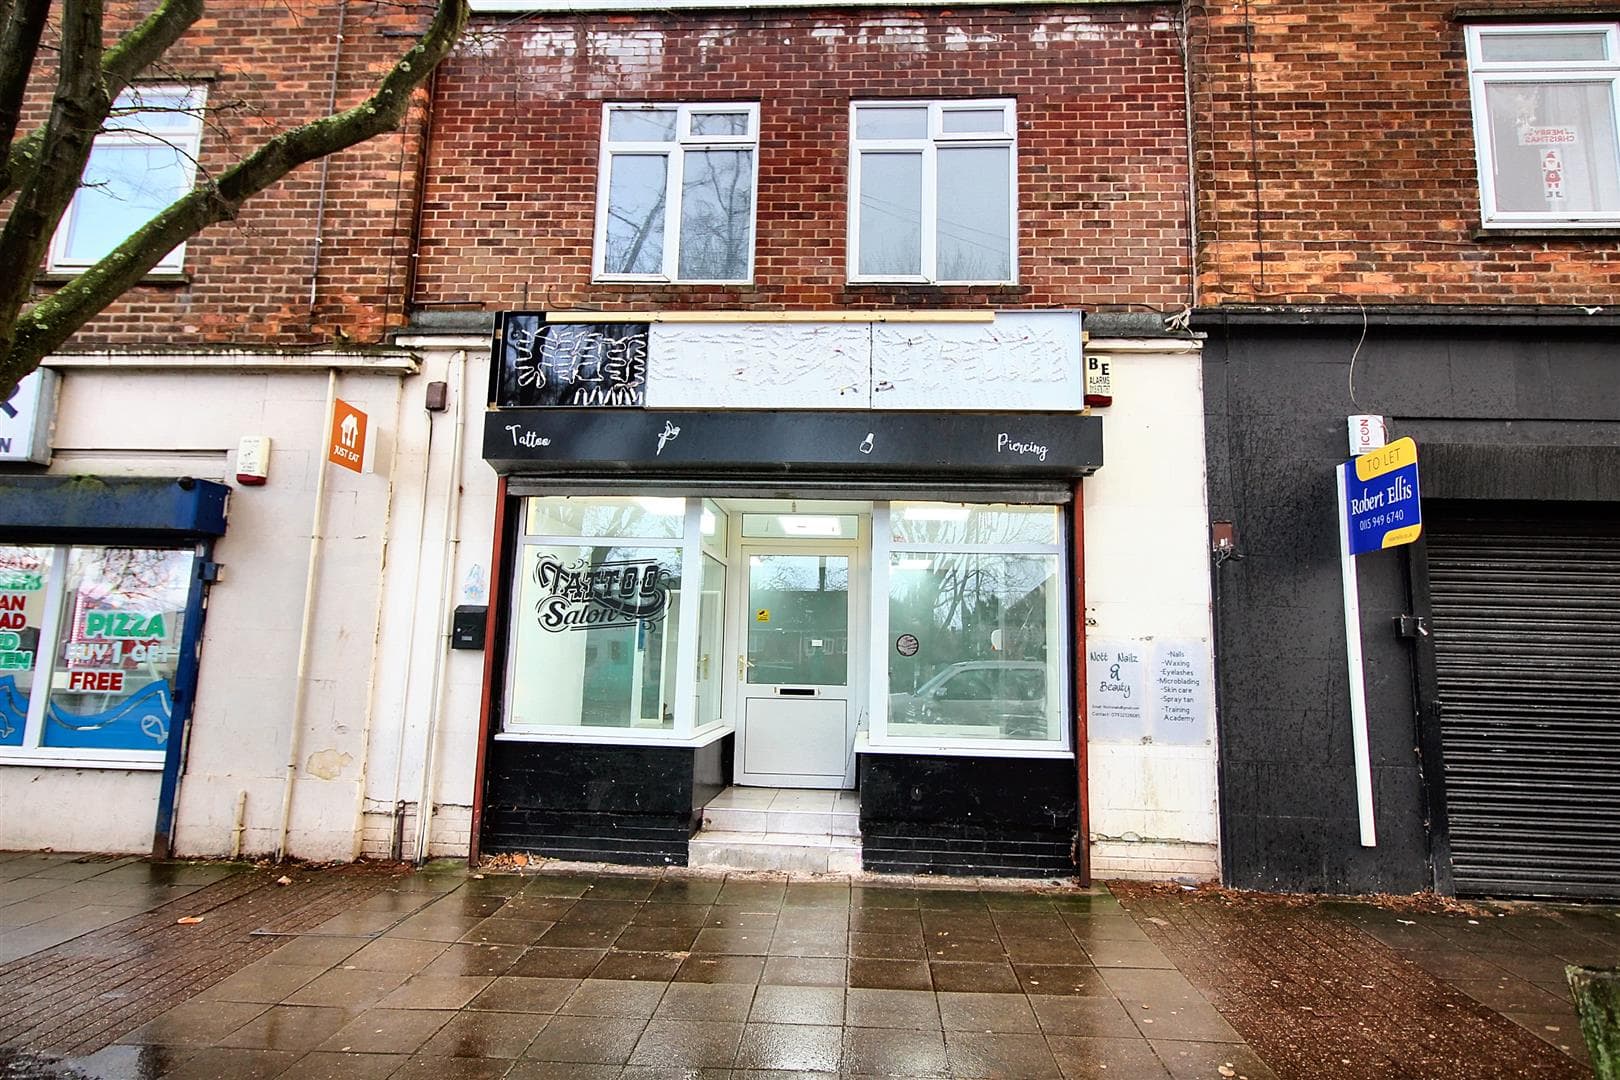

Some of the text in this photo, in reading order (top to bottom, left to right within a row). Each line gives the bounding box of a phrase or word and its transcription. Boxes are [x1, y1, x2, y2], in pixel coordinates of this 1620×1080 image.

[505, 424, 551, 448] Tattoo
[1360, 419, 1370, 446] ICON
[333, 445, 360, 463] JUST EAT
[997, 433, 1049, 461] Piercing
[1367, 448, 1401, 472] TO LET
[1352, 475, 1413, 516] Robert Ellis
[1372, 514, 1385, 528] 949
[1386, 509, 1404, 524] 6740
[537, 560, 660, 602] TATTOO
[85, 612, 166, 638] PIZZA
[542, 600, 620, 627] Salon
[1090, 652, 1139, 663] Nott Nailz
[68, 671, 124, 691] FREE
[1099, 681, 1131, 699] Beauty
[1163, 715, 1195, 723] Academy
